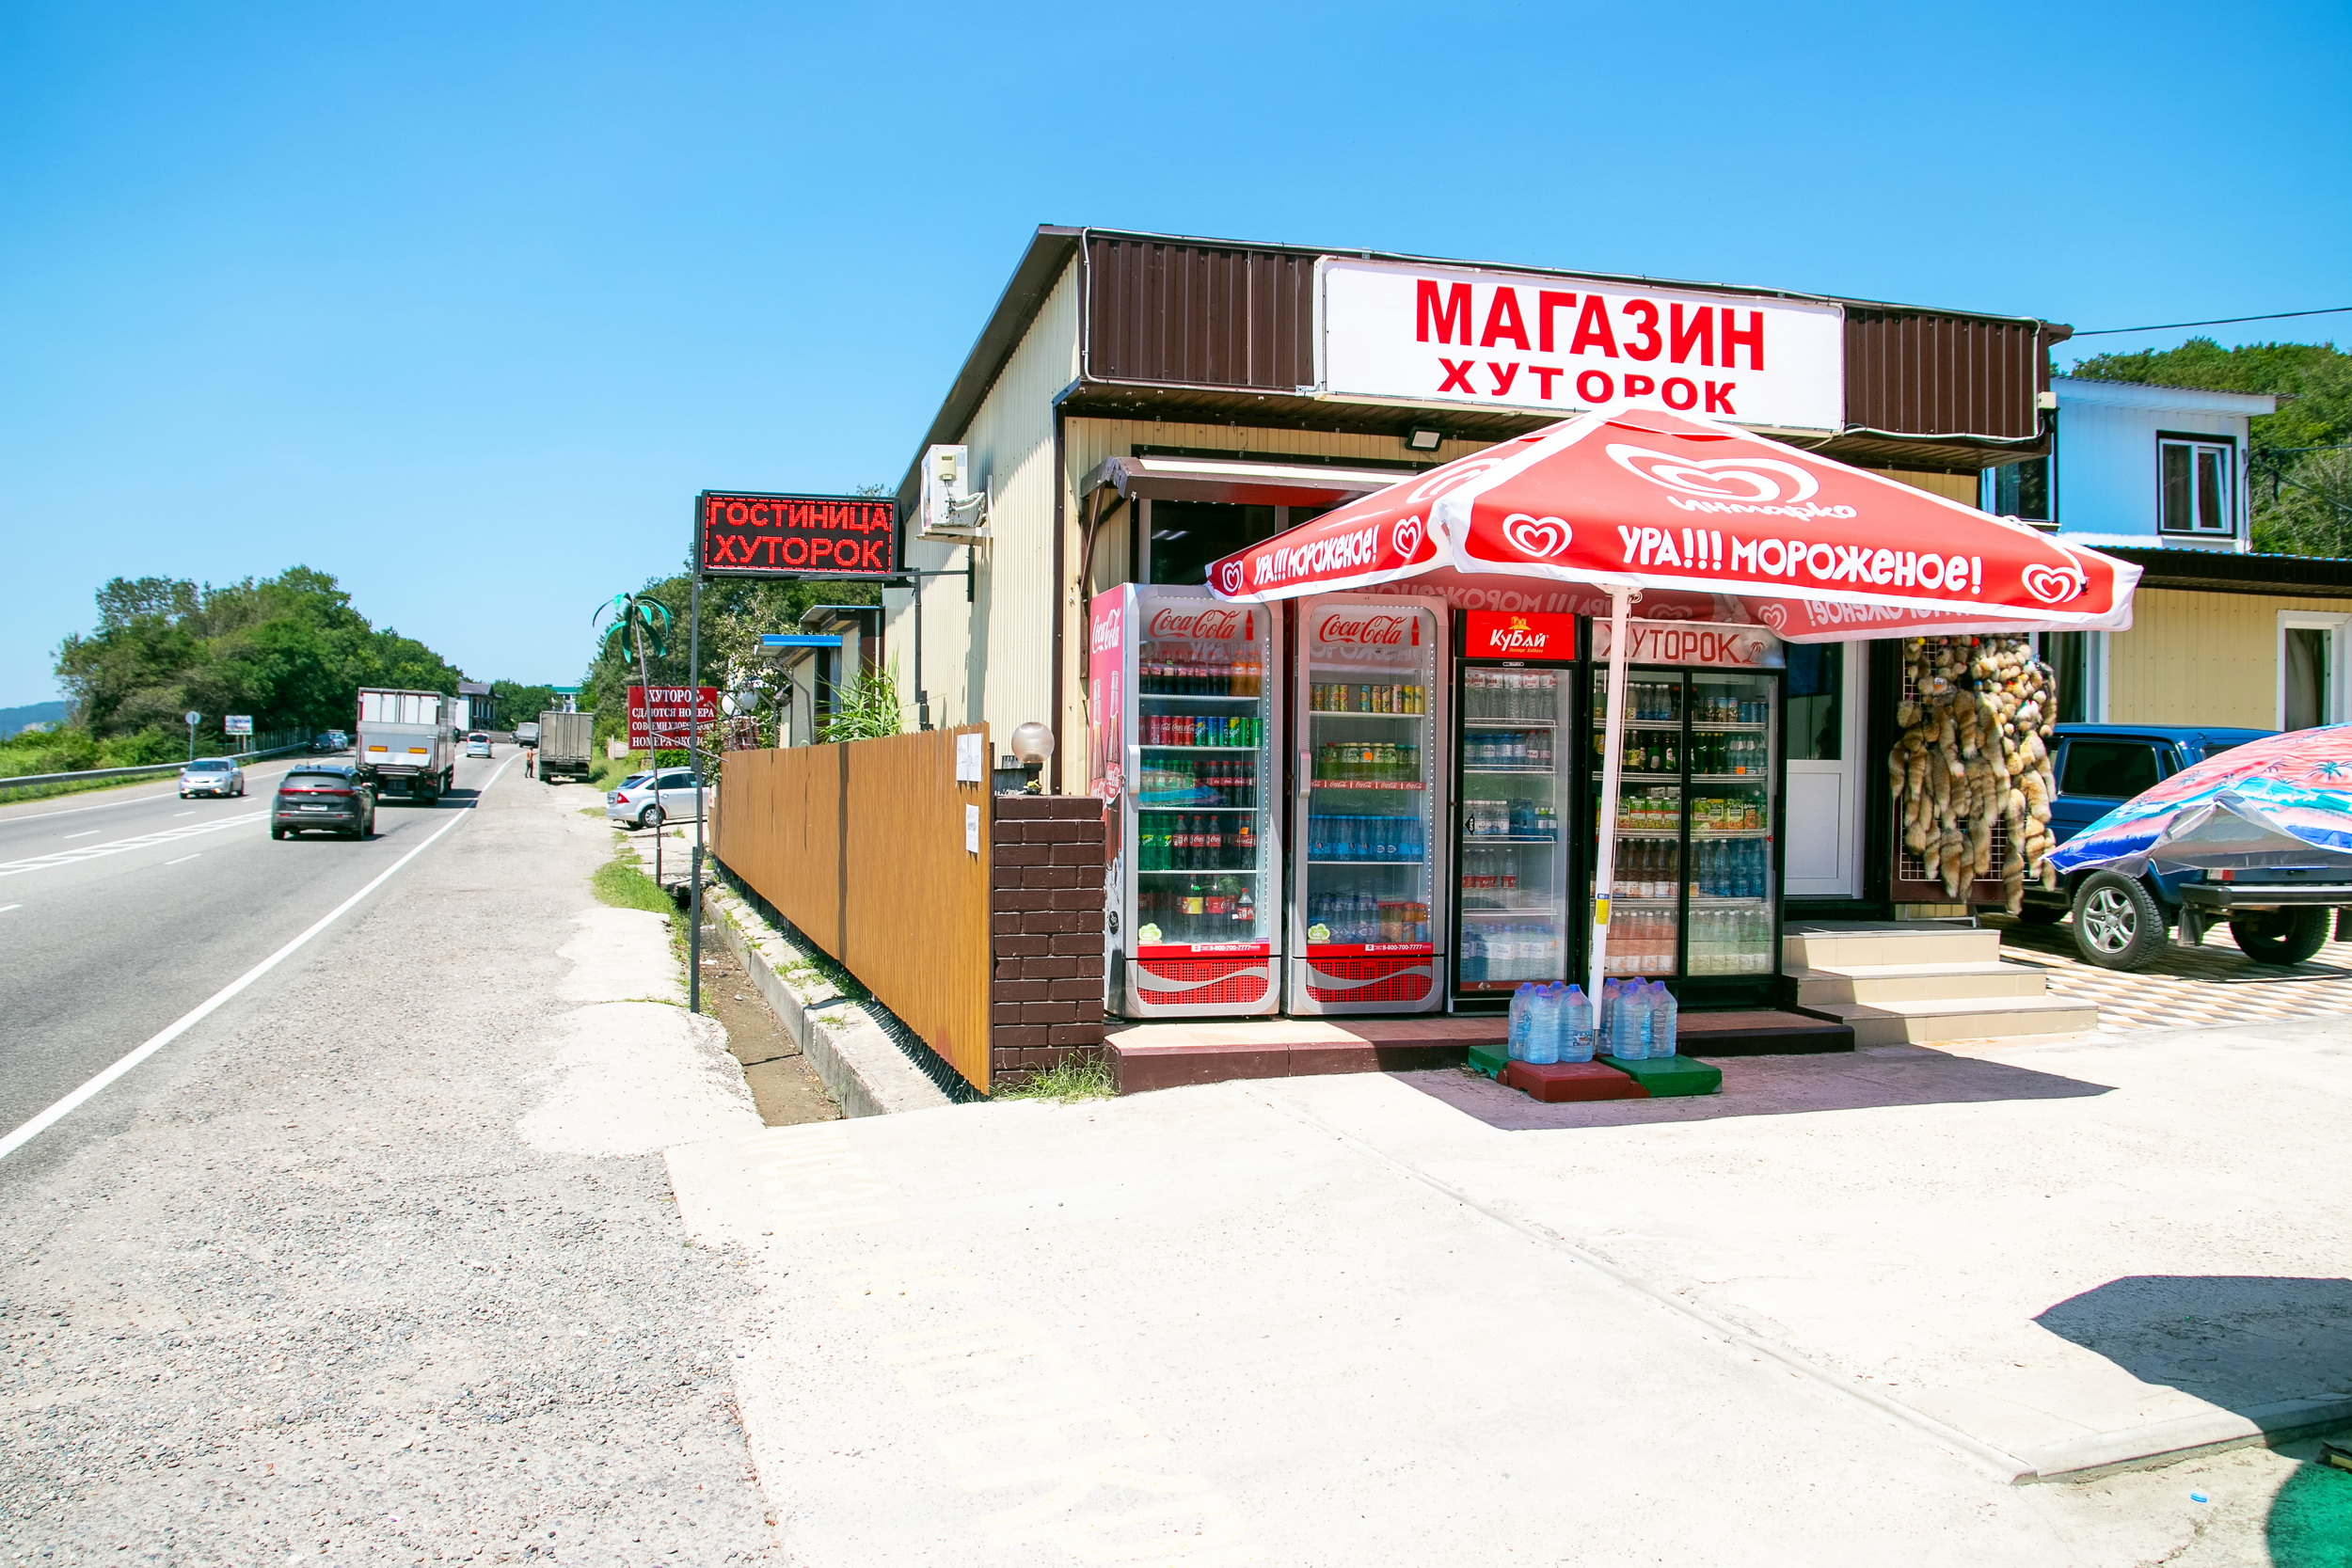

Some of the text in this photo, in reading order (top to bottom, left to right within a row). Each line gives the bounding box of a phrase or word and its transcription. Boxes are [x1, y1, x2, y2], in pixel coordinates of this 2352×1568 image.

[1415, 278, 1765, 372] МАГАЗИН
[1436, 357, 1738, 415] ХУТОРОК
[709, 501, 890, 534] ГОСТИНИЦА
[713, 533, 883, 568] ХУТОРОК
[1617, 524, 1723, 571] УРА!!!
[1092, 607, 1121, 654] Coca-Cola
[1149, 608, 1241, 639] Coca-Cola
[1319, 613, 1407, 644] Coca-Cola
[678, 707, 714, 718] НОЕРА
